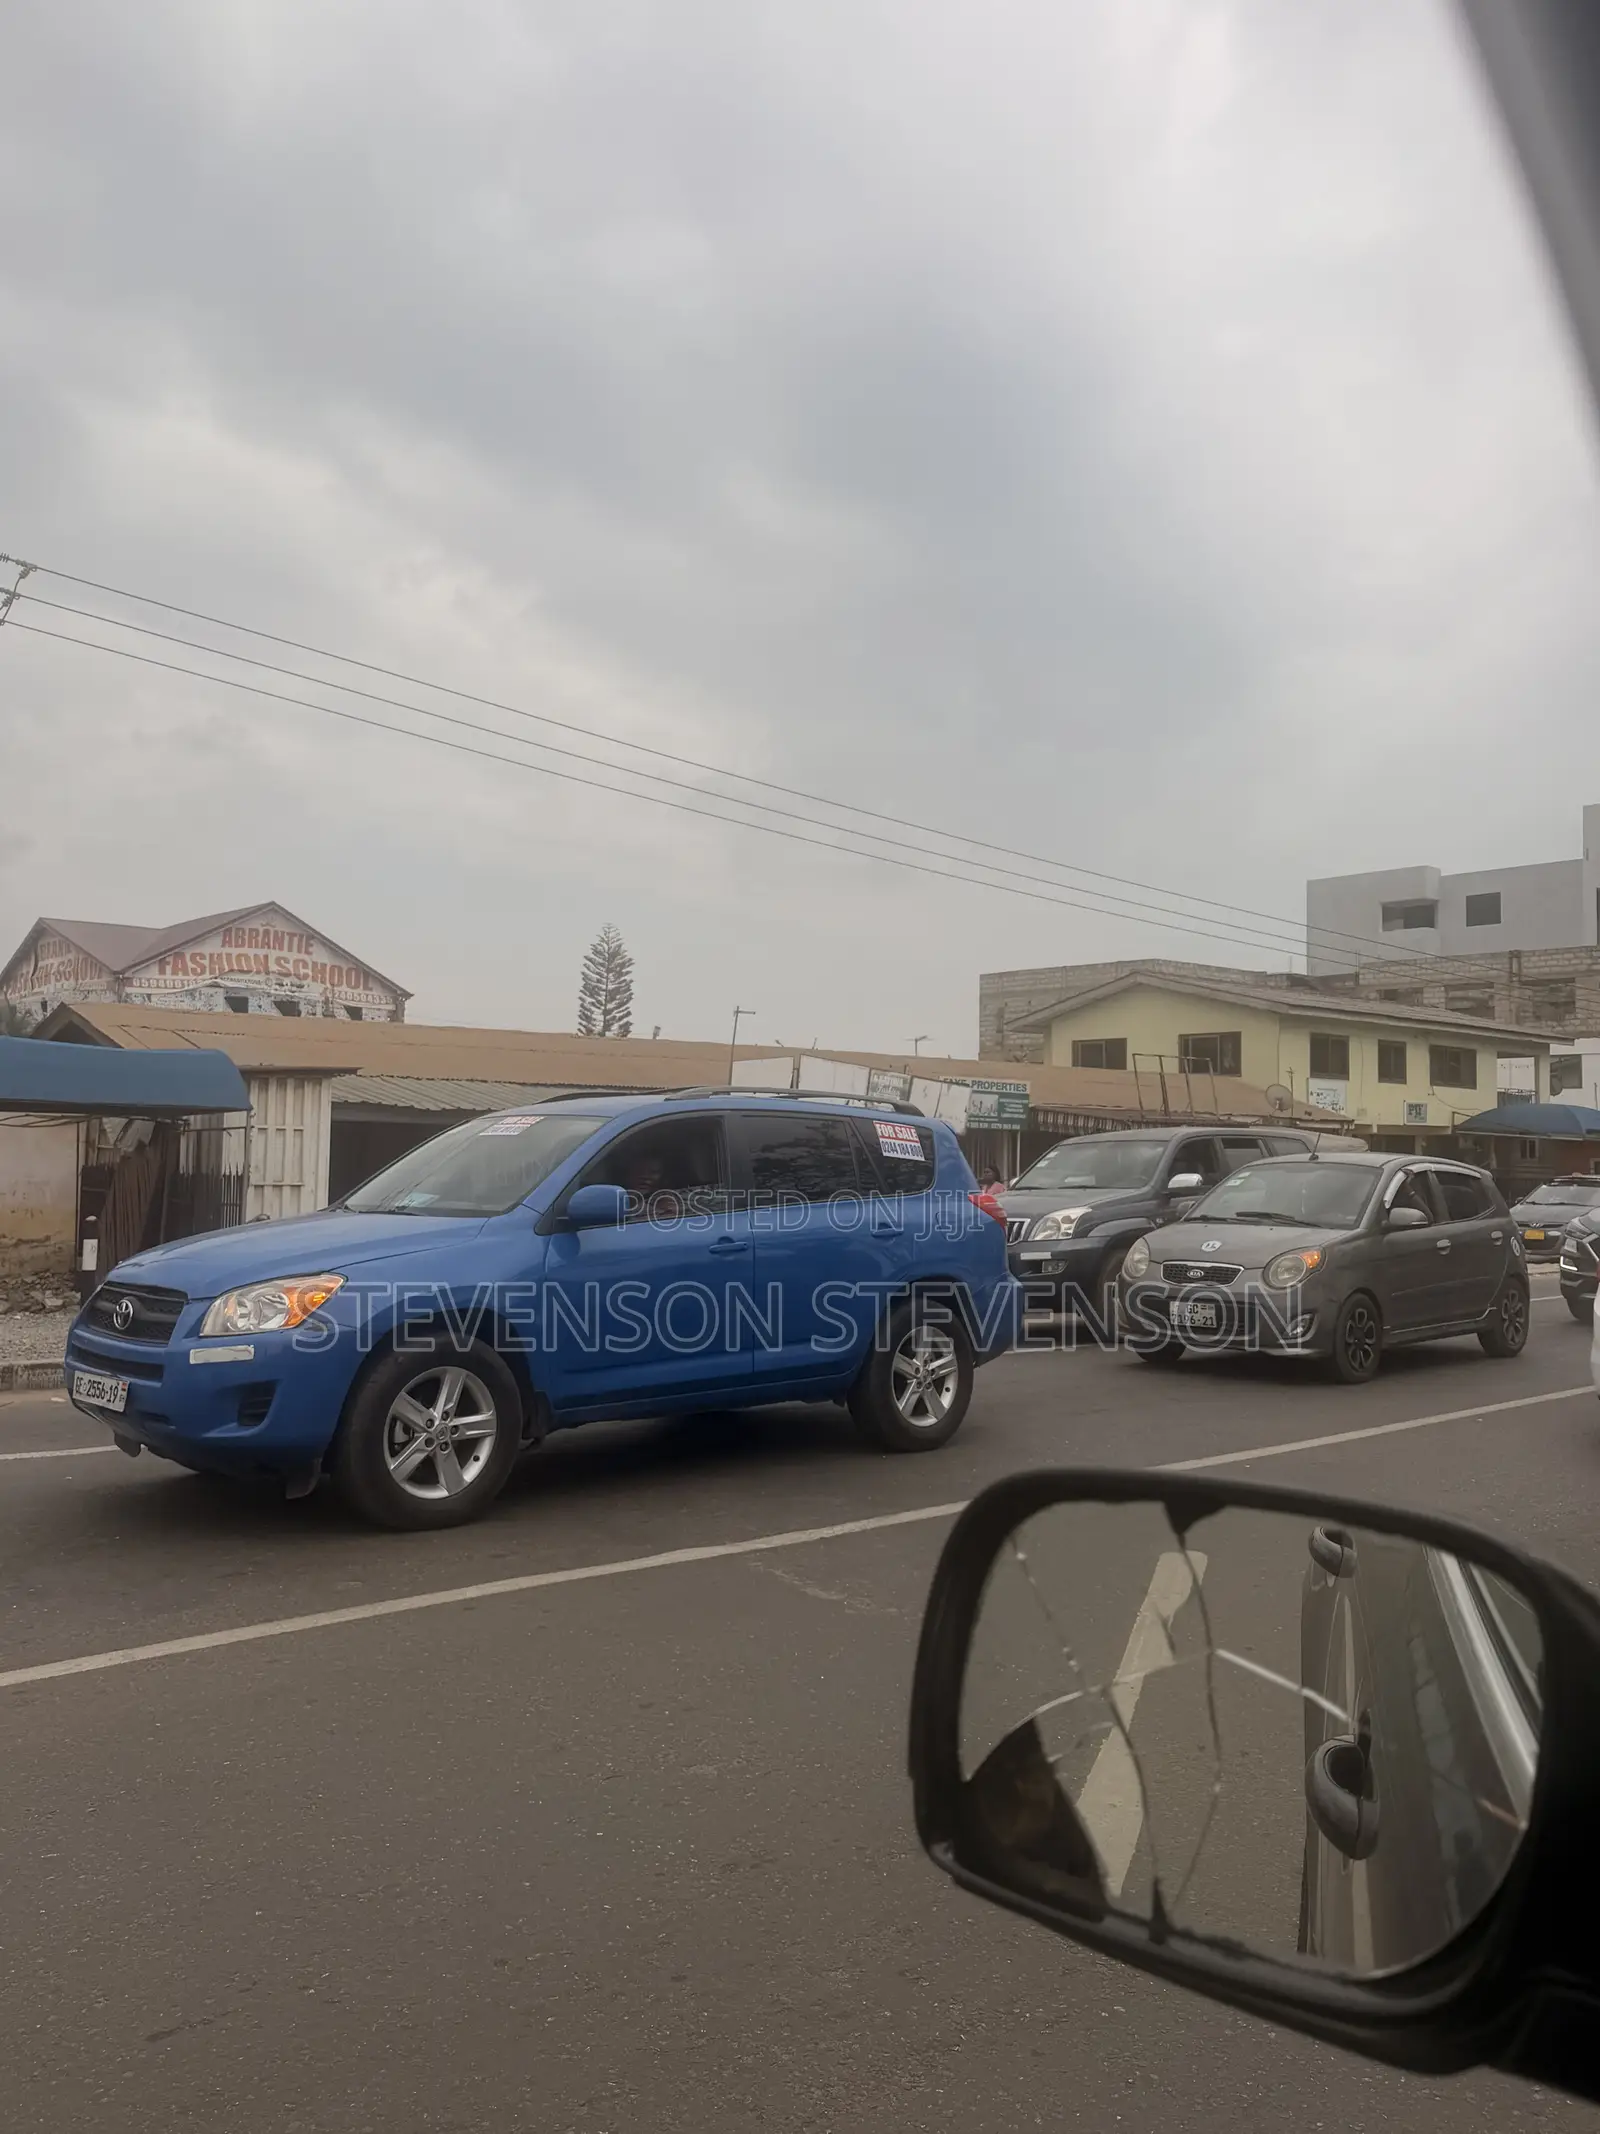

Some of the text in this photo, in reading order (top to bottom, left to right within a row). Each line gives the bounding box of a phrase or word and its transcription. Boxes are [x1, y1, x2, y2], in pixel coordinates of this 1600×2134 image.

[221, 926, 314, 956] ABRANTIE
[157, 951, 271, 977] FASHION
[274, 955, 374, 992] SCHOOL
[971, 1080, 1028, 1093] PROPERTIES
[873, 1123, 919, 1141] FOR SALE
[87, 1379, 120, 1404] 2556-19
